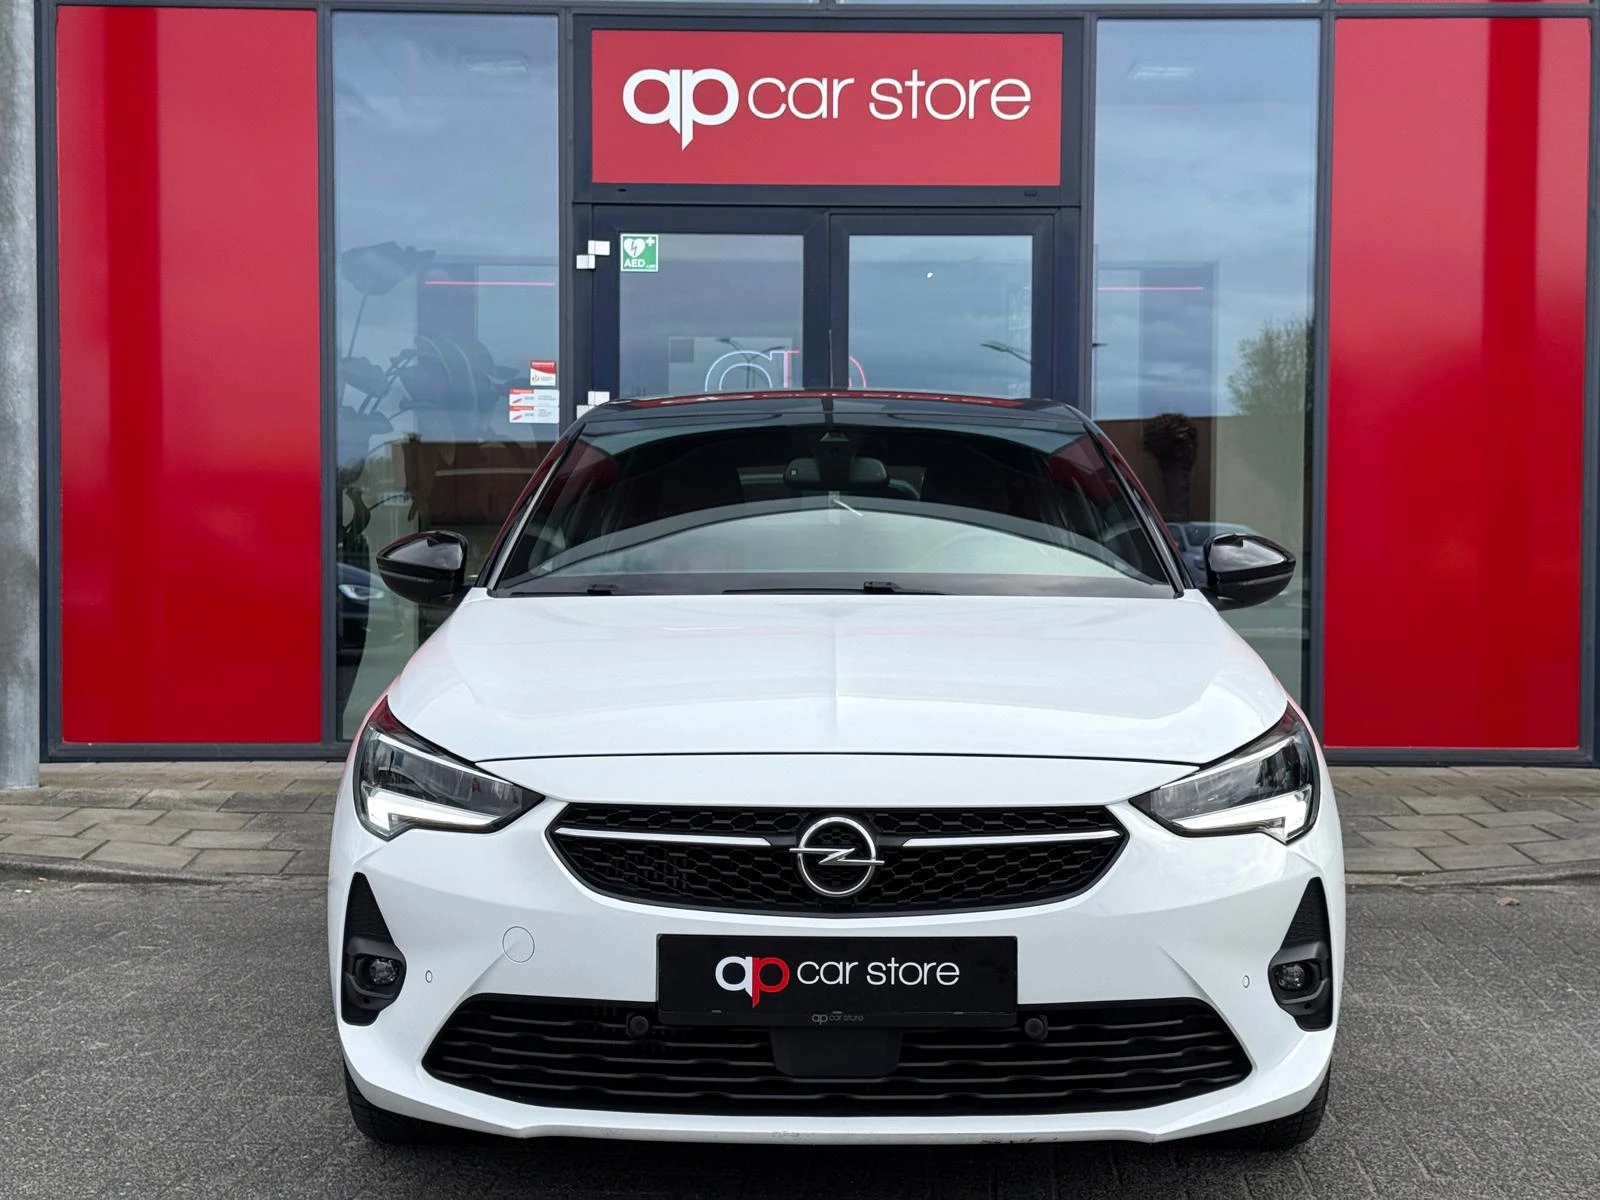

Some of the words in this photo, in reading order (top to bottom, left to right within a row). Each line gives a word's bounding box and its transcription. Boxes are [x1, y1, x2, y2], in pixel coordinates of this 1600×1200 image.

[622, 68, 739, 151] ap
[747, 77, 855, 119] car
[869, 69, 1032, 120] store
[624, 258, 646, 268] AED
[715, 956, 790, 1008] ap
[797, 961, 859, 985] car
[866, 957, 960, 986] store
[829, 1014, 842, 1022] car
[843, 1014, 864, 1022] store
